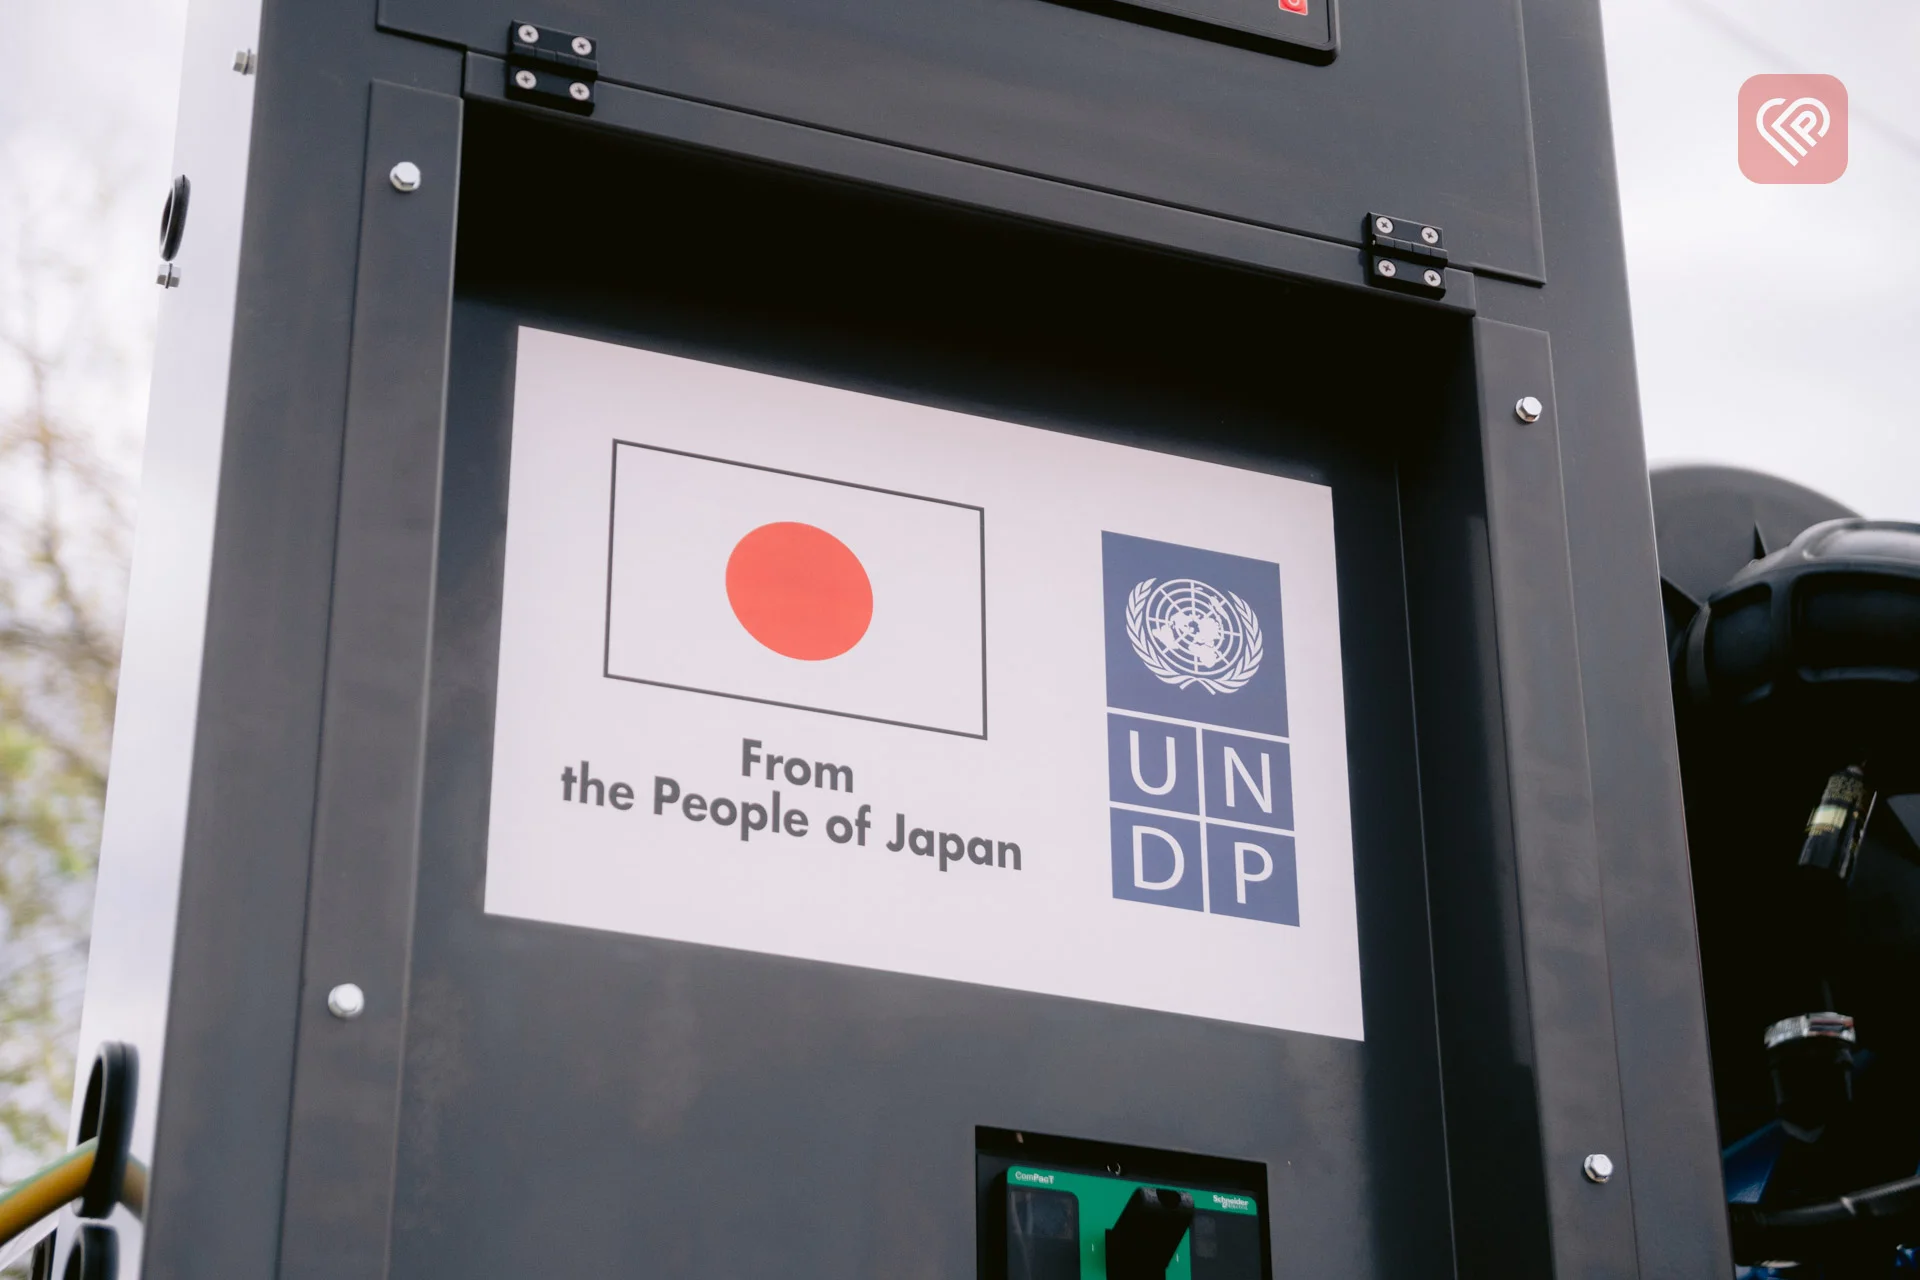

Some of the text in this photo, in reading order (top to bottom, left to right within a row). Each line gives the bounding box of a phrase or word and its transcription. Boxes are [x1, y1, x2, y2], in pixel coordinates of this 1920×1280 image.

[741, 737, 854, 793] From
[561, 760, 1022, 872] the People of Japan
